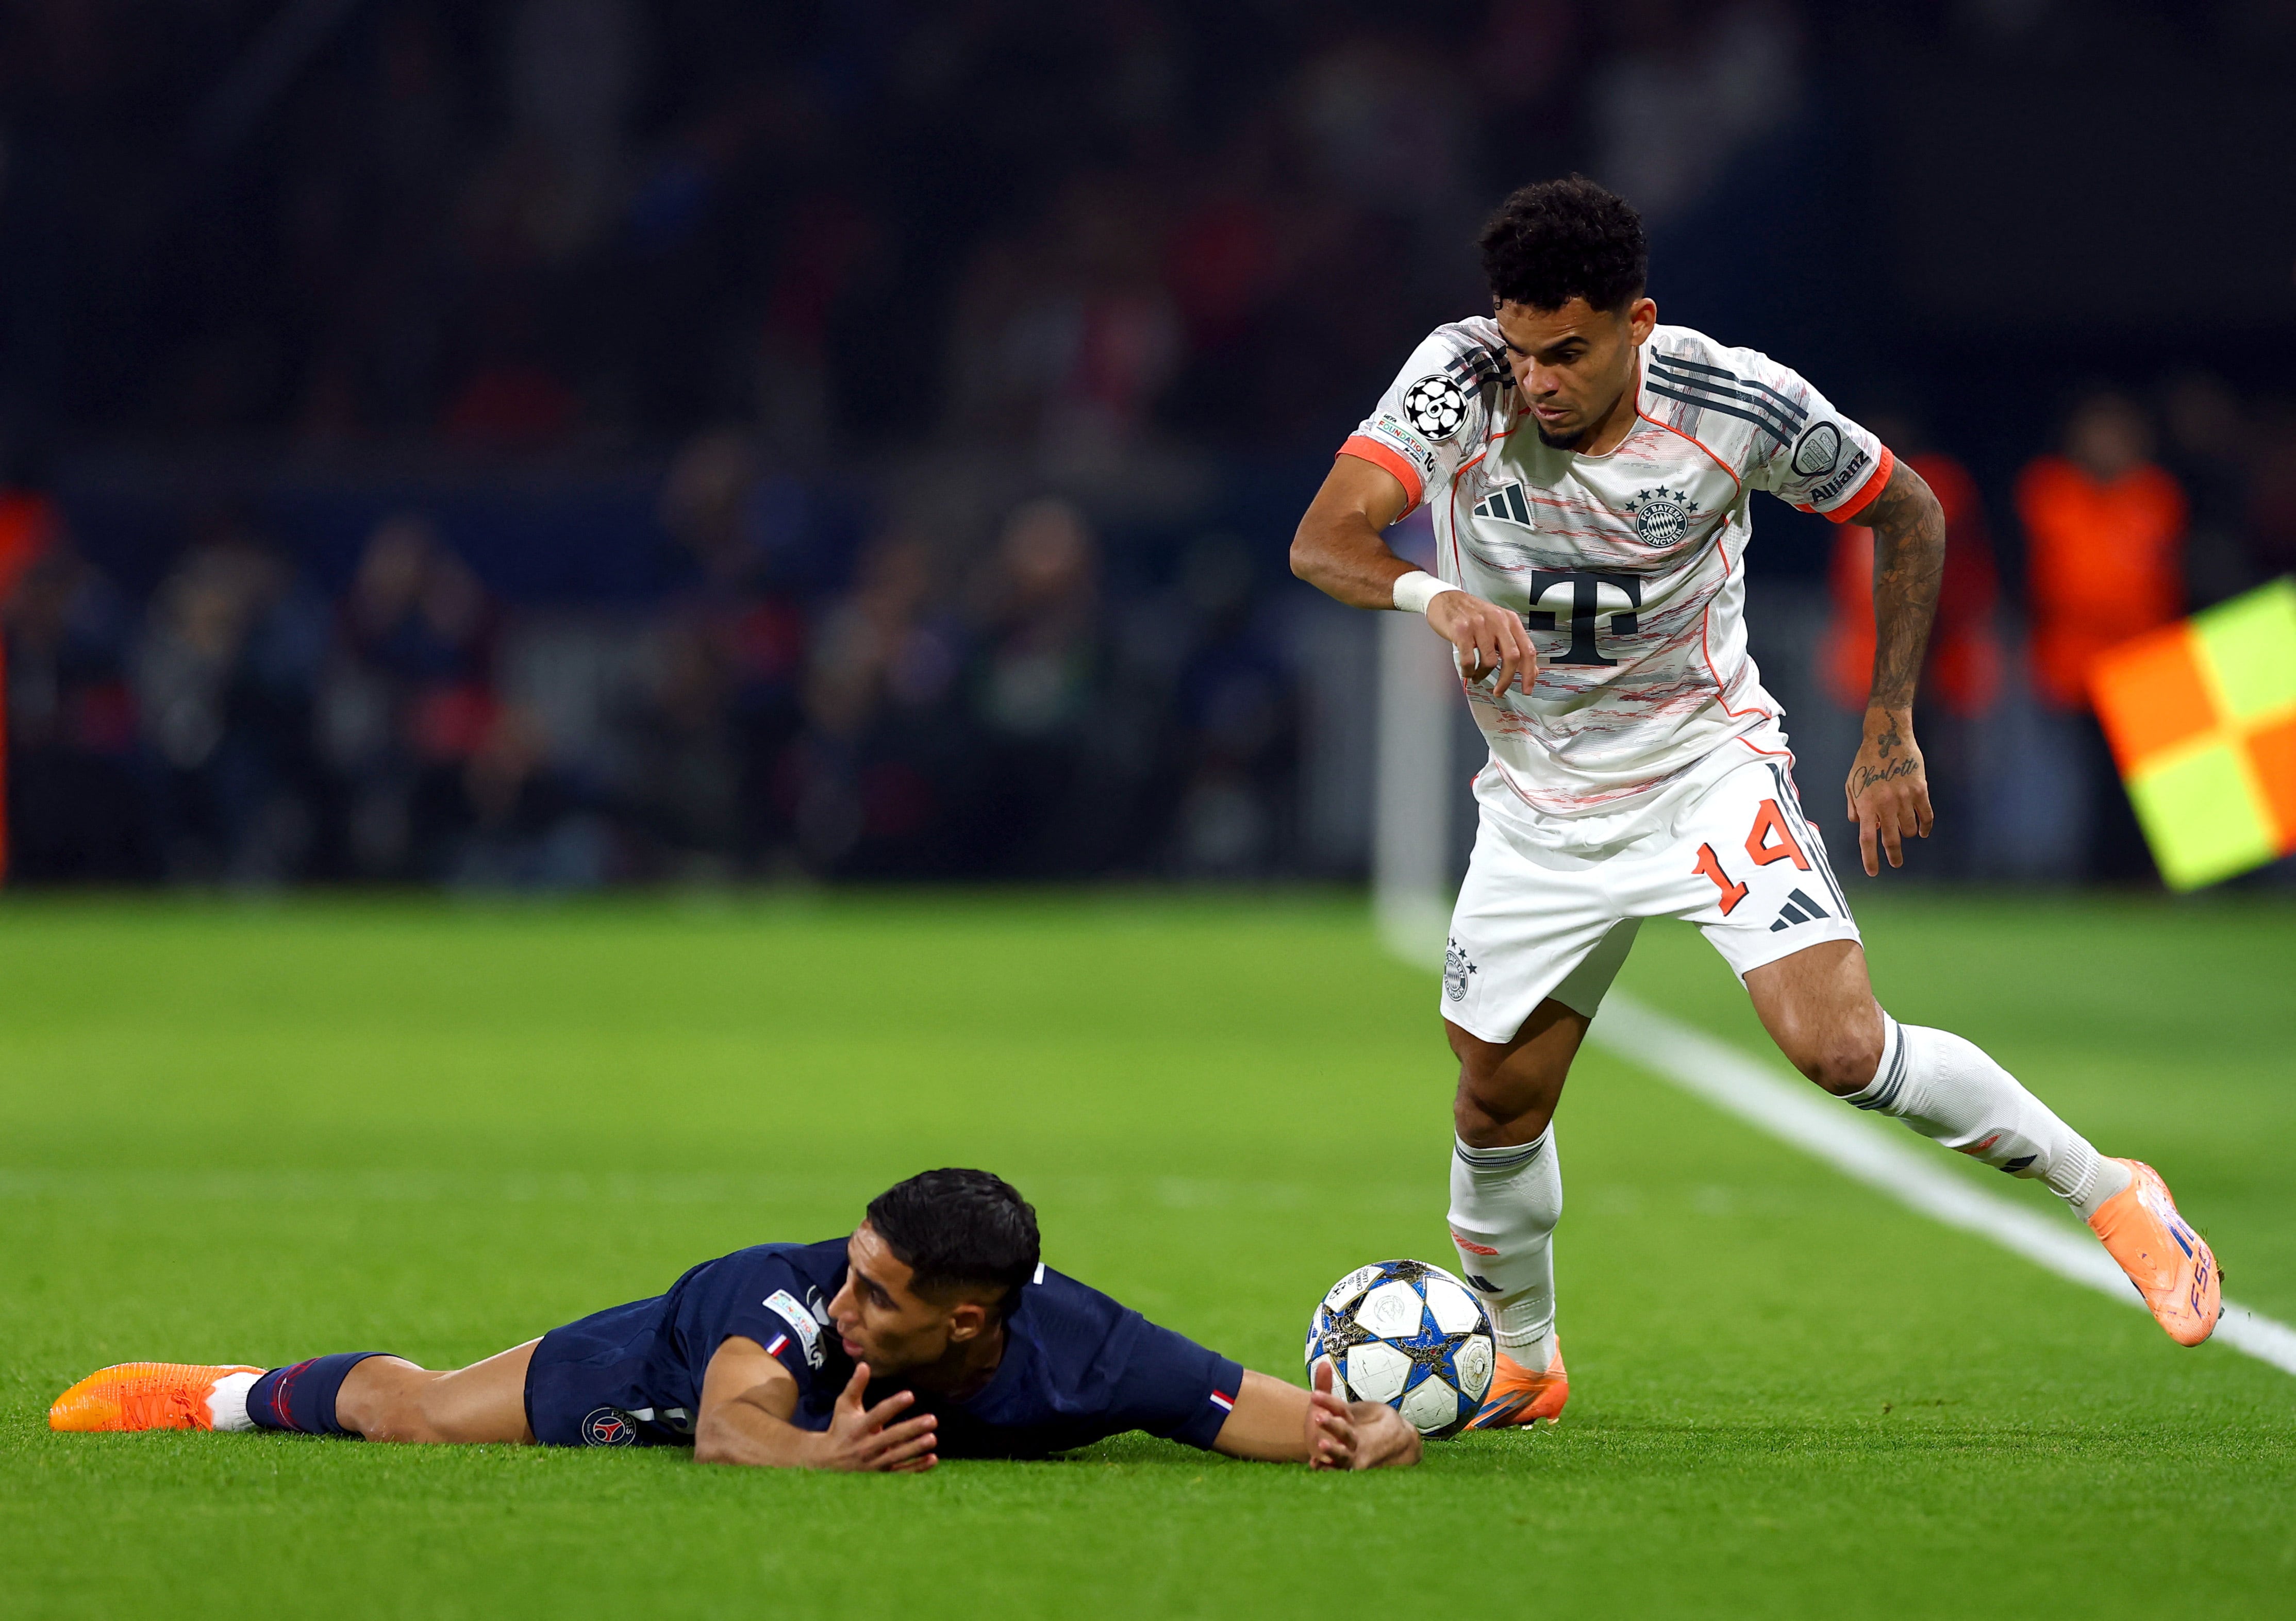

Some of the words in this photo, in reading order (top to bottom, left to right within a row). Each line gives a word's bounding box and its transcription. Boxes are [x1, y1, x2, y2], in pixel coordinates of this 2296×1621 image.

[1426, 396, 1447, 419] 6
[1378, 421, 1426, 457] FOUNDATION
[1810, 450, 1869, 503] Allianz
[1640, 510, 1651, 521] FC
[1651, 505, 1684, 522] BAYERN
[1853, 758, 1919, 798] Charlotte
[1691, 798, 1812, 917] 14
[611, 1410, 634, 1435] PARIS
